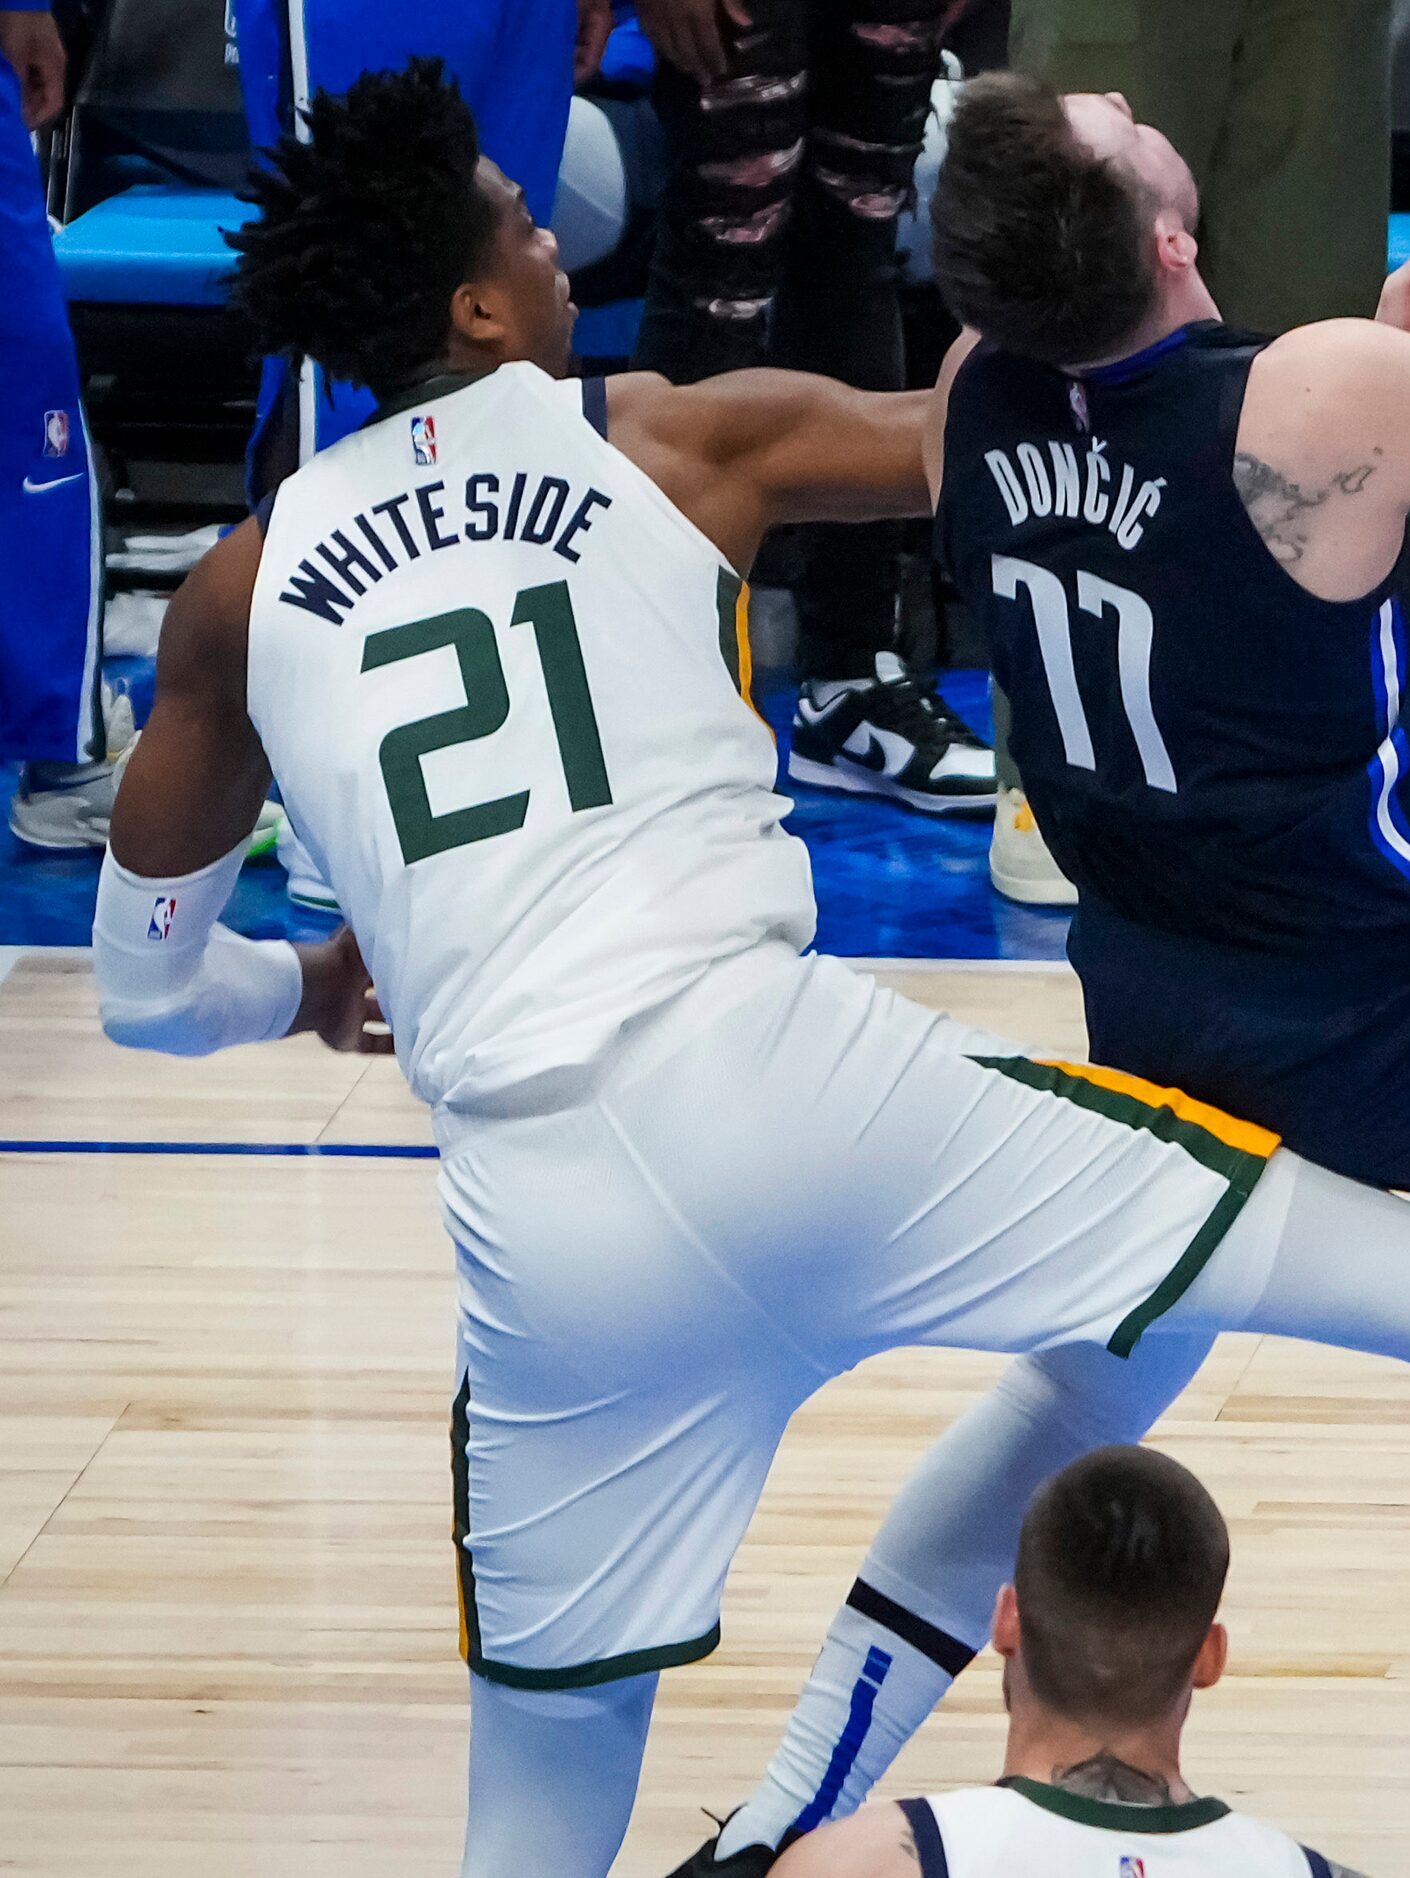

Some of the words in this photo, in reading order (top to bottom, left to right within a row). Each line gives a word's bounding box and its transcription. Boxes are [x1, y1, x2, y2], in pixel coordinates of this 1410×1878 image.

[278, 472, 613, 626] WHITESIDE
[984, 436, 1167, 550] DONČIĆ
[360, 579, 614, 867] 21
[991, 553, 1178, 794] 77
